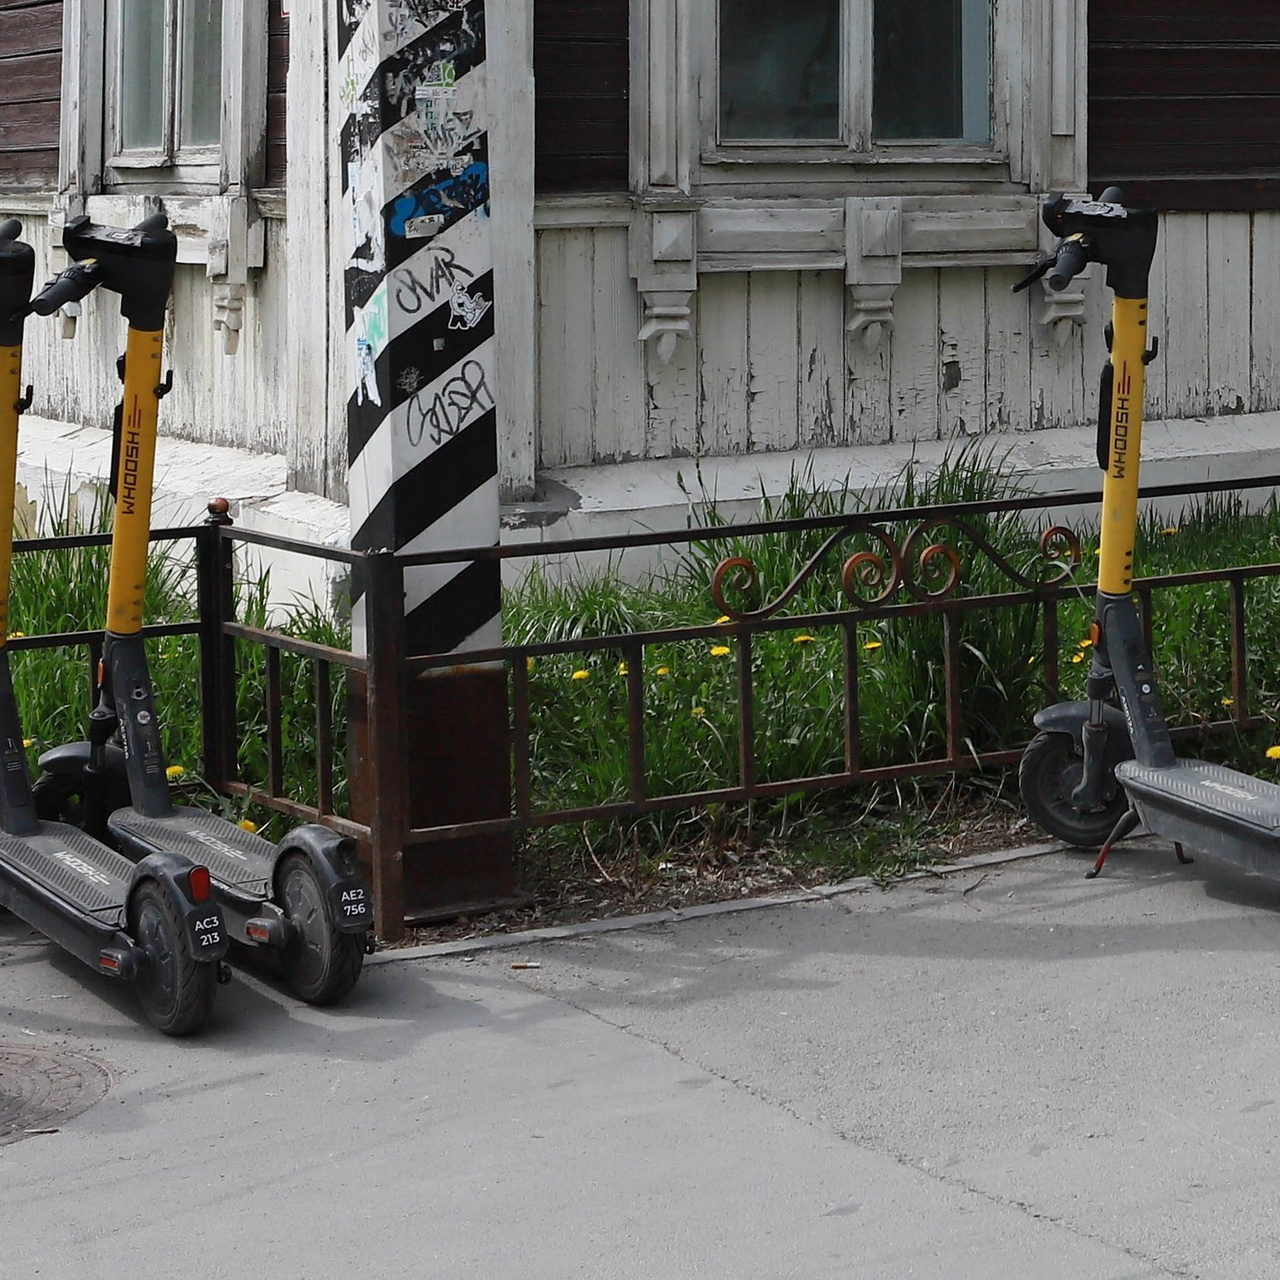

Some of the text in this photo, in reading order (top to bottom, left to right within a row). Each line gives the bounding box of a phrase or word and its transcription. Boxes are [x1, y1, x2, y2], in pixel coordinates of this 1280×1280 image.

[1113, 397, 1130, 479] WHOOSH
[122, 431, 140, 515] WHOOSH
[341, 889, 364, 902] AE2
[343, 903, 366, 916] 756
[194, 916, 219, 931] AC3
[200, 932, 220, 946] 213
